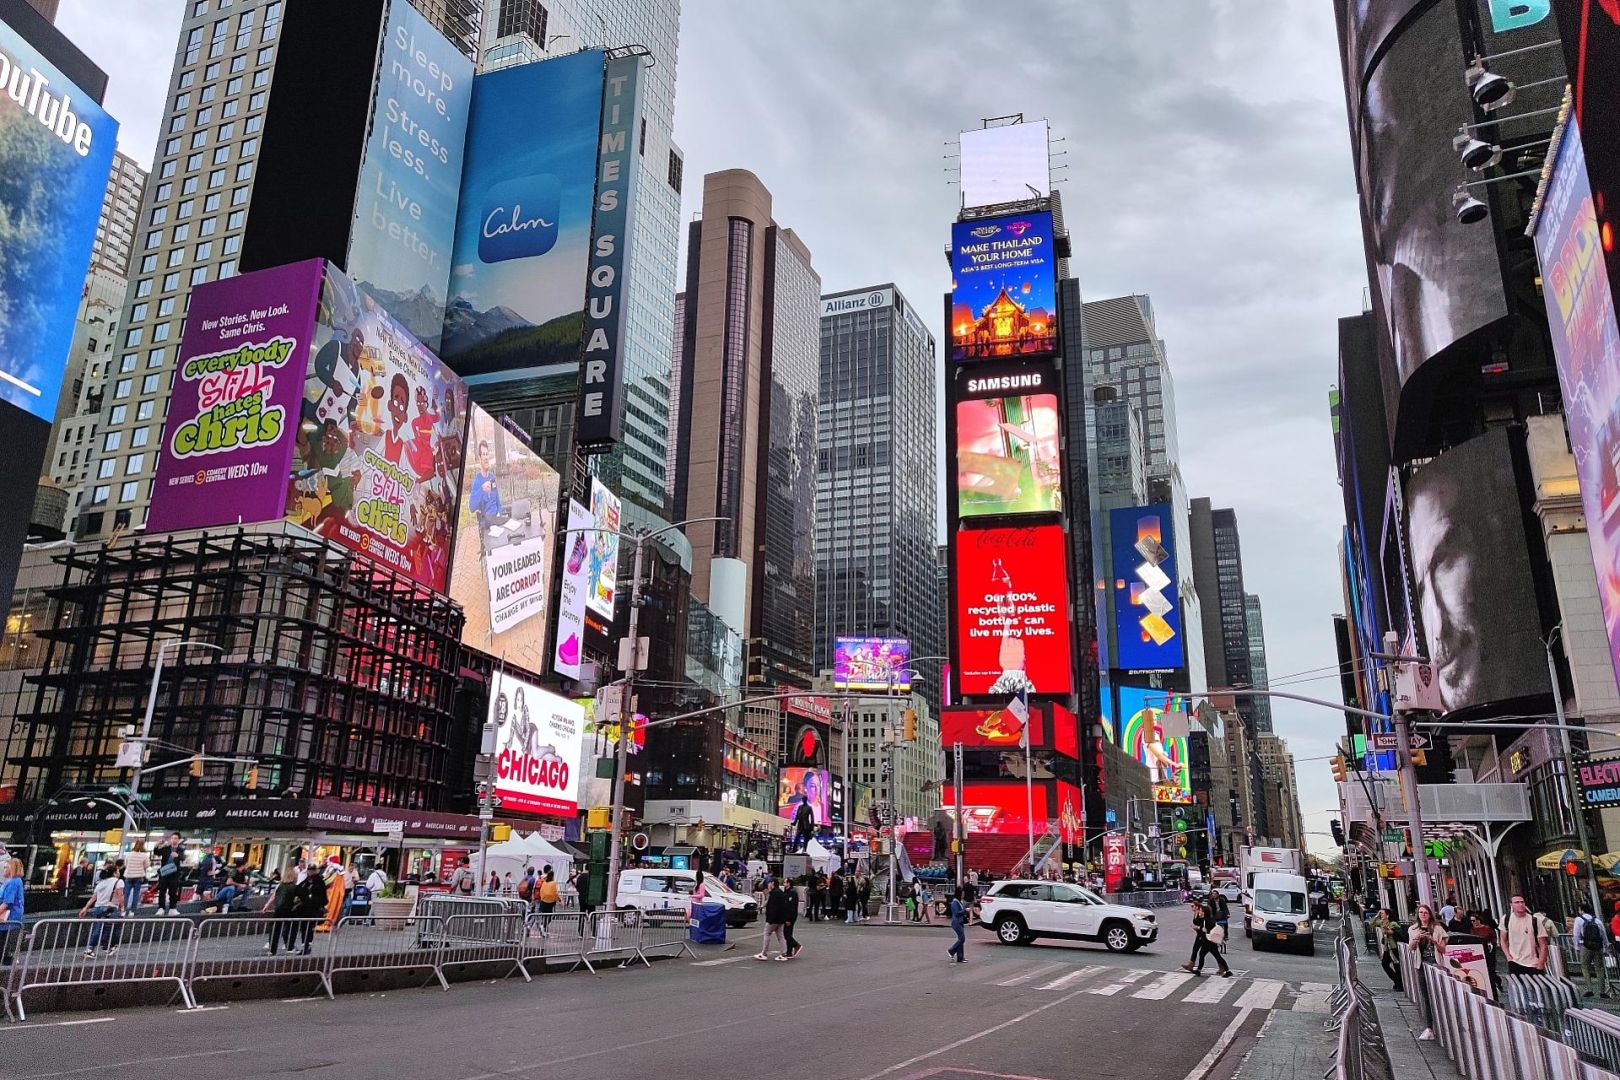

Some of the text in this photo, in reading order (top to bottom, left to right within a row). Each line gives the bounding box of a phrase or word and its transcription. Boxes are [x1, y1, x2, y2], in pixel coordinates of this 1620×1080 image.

[394, 26, 453, 91] Sleep
[392, 59, 452, 122] more.
[386, 98, 449, 164] Stress
[381, 126, 430, 181] less.
[376, 171, 423, 220] Live
[483, 204, 554, 238] Calm
[371, 202, 441, 271] better.
[583, 75, 628, 418] TIMES SQUARE
[961, 236, 1043, 254] MAKE THAILAND
[960, 265, 980, 273] ASIA'S
[980, 263, 994, 271] BEST
[994, 260, 1030, 270] LONG-TERM
[971, 248, 1033, 264] YOUR HOME
[824, 298, 866, 313] Allianz
[201, 303, 289, 332] New Stories. New Look.
[219, 322, 265, 340] Same Chris.
[375, 326, 387, 344] New
[184, 338, 295, 377] everybody
[967, 374, 1042, 392] SAMSUNG
[212, 390, 263, 422] hates
[173, 404, 282, 455] chris
[168, 473, 195, 486] NEW SERIES
[205, 473, 227, 483] CENTRAL
[206, 467, 228, 476] COMEDY
[227, 462, 268, 480] WEDS 10PM
[365, 450, 414, 493] everybody
[358, 498, 408, 545] chris
[384, 547, 400, 565] WEDS
[492, 549, 541, 580] YOUR LEADERS
[495, 571, 541, 603] ARE CORRUPT
[563, 579, 578, 596] Enjoy
[985, 593, 1037, 602] Our 100%
[494, 594, 543, 624] CHANGE MY MIND
[968, 603, 1055, 615] recycled plastic
[970, 626, 1054, 637] live many lives.
[1024, 617, 1045, 625] can
[497, 746, 569, 791] CHICAGO
[1, 814, 20, 822] EAGLE
[80, 812, 99, 820] EAGLE
[166, 810, 189, 818] EAGLE
[226, 809, 269, 817] AMERICAN
[273, 810, 300, 818] EAGLE
[308, 811, 335, 821] AMERICAN
[336, 814, 352, 824] EAGLE
[1109, 839, 1122, 866] tkts
